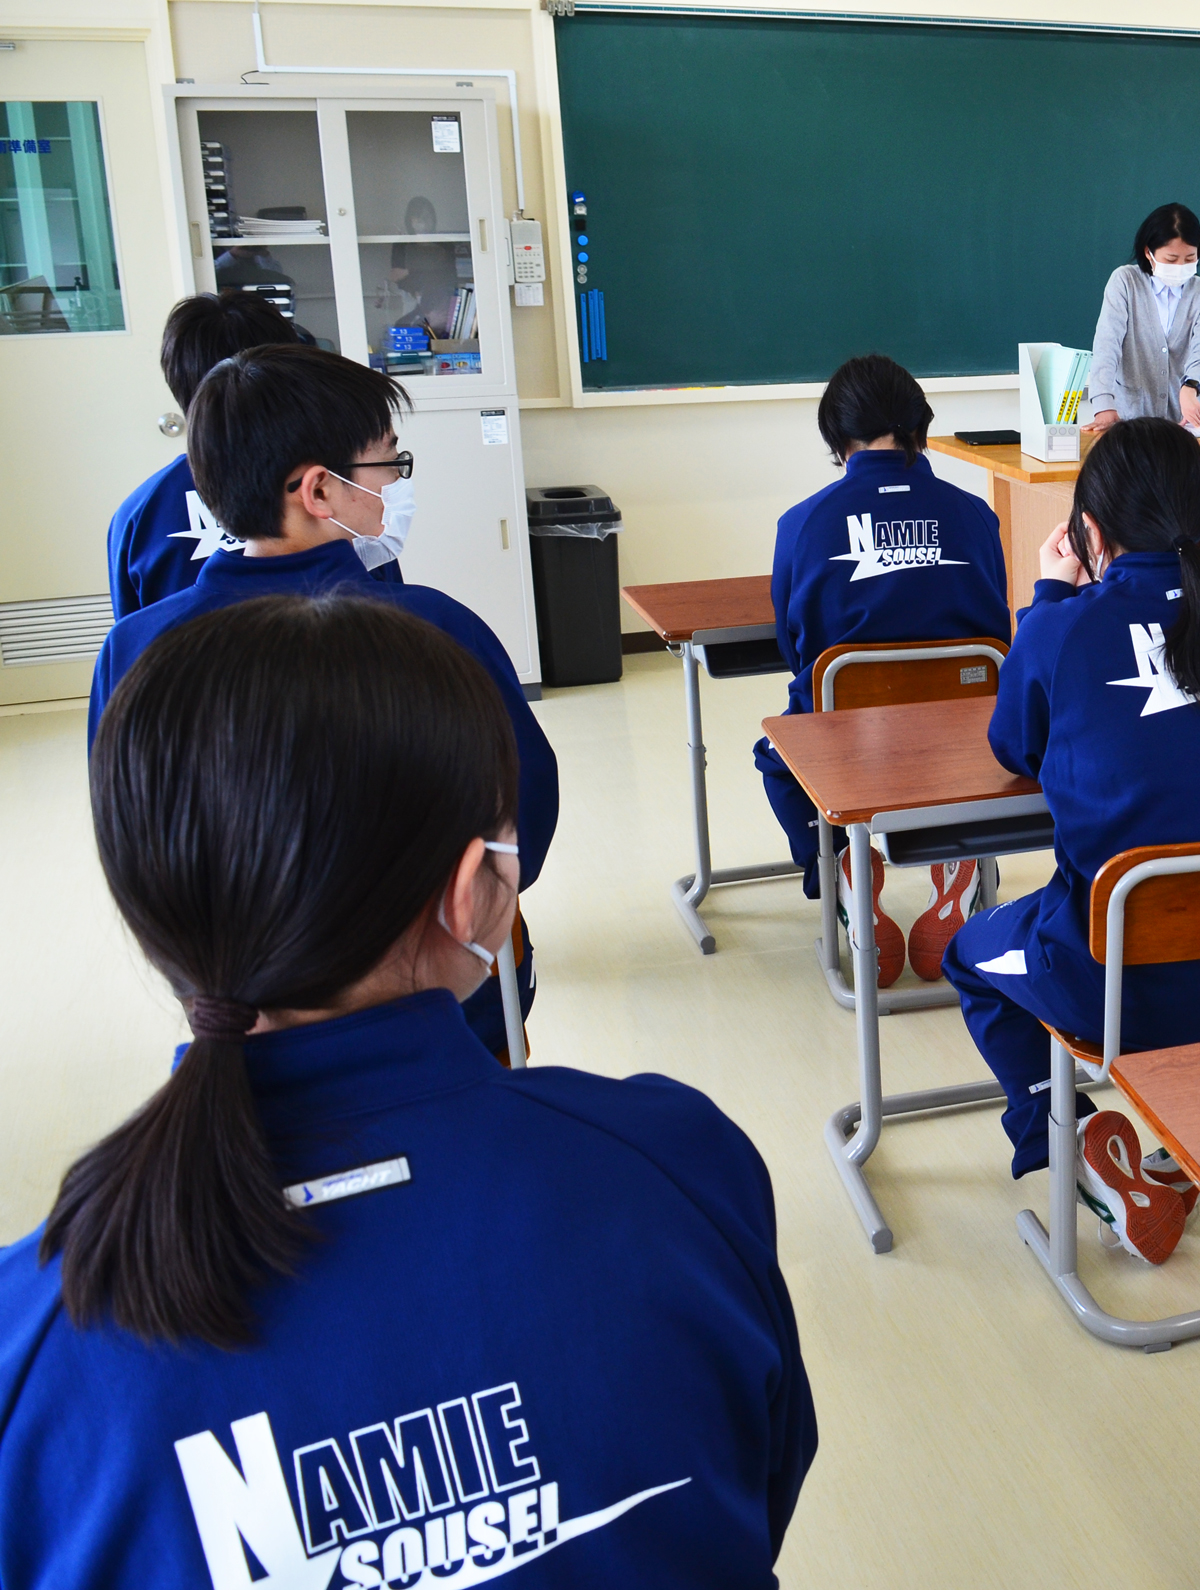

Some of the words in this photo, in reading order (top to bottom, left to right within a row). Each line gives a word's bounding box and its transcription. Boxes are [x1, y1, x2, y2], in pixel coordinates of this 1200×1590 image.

[847, 513, 939, 553] NAMIE
[882, 547, 942, 567] SOUSE!
[174, 1381, 541, 1588] NAMIE
